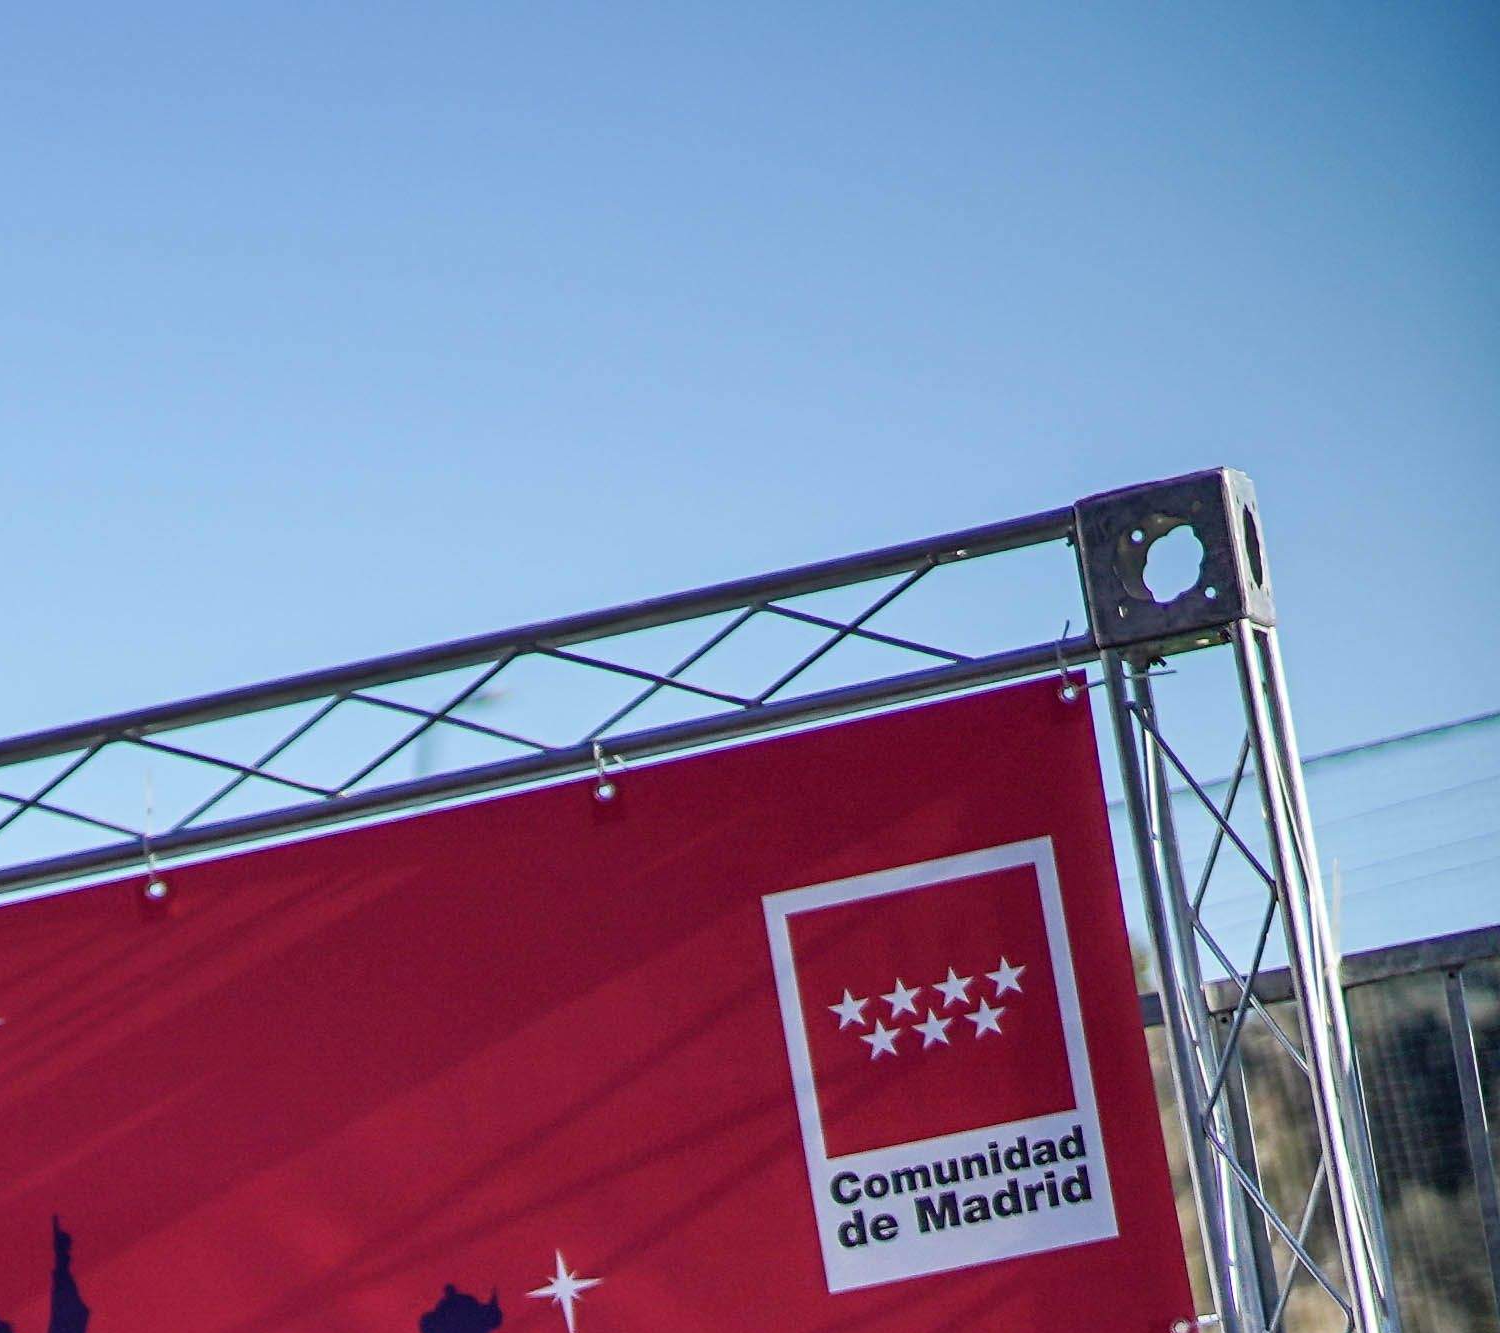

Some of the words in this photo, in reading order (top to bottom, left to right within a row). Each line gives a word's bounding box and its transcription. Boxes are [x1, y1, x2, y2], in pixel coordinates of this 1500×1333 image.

[829, 1124, 1088, 1206] Comunidad
[837, 1209, 900, 1249] de
[914, 1166, 1094, 1236] Madrid
